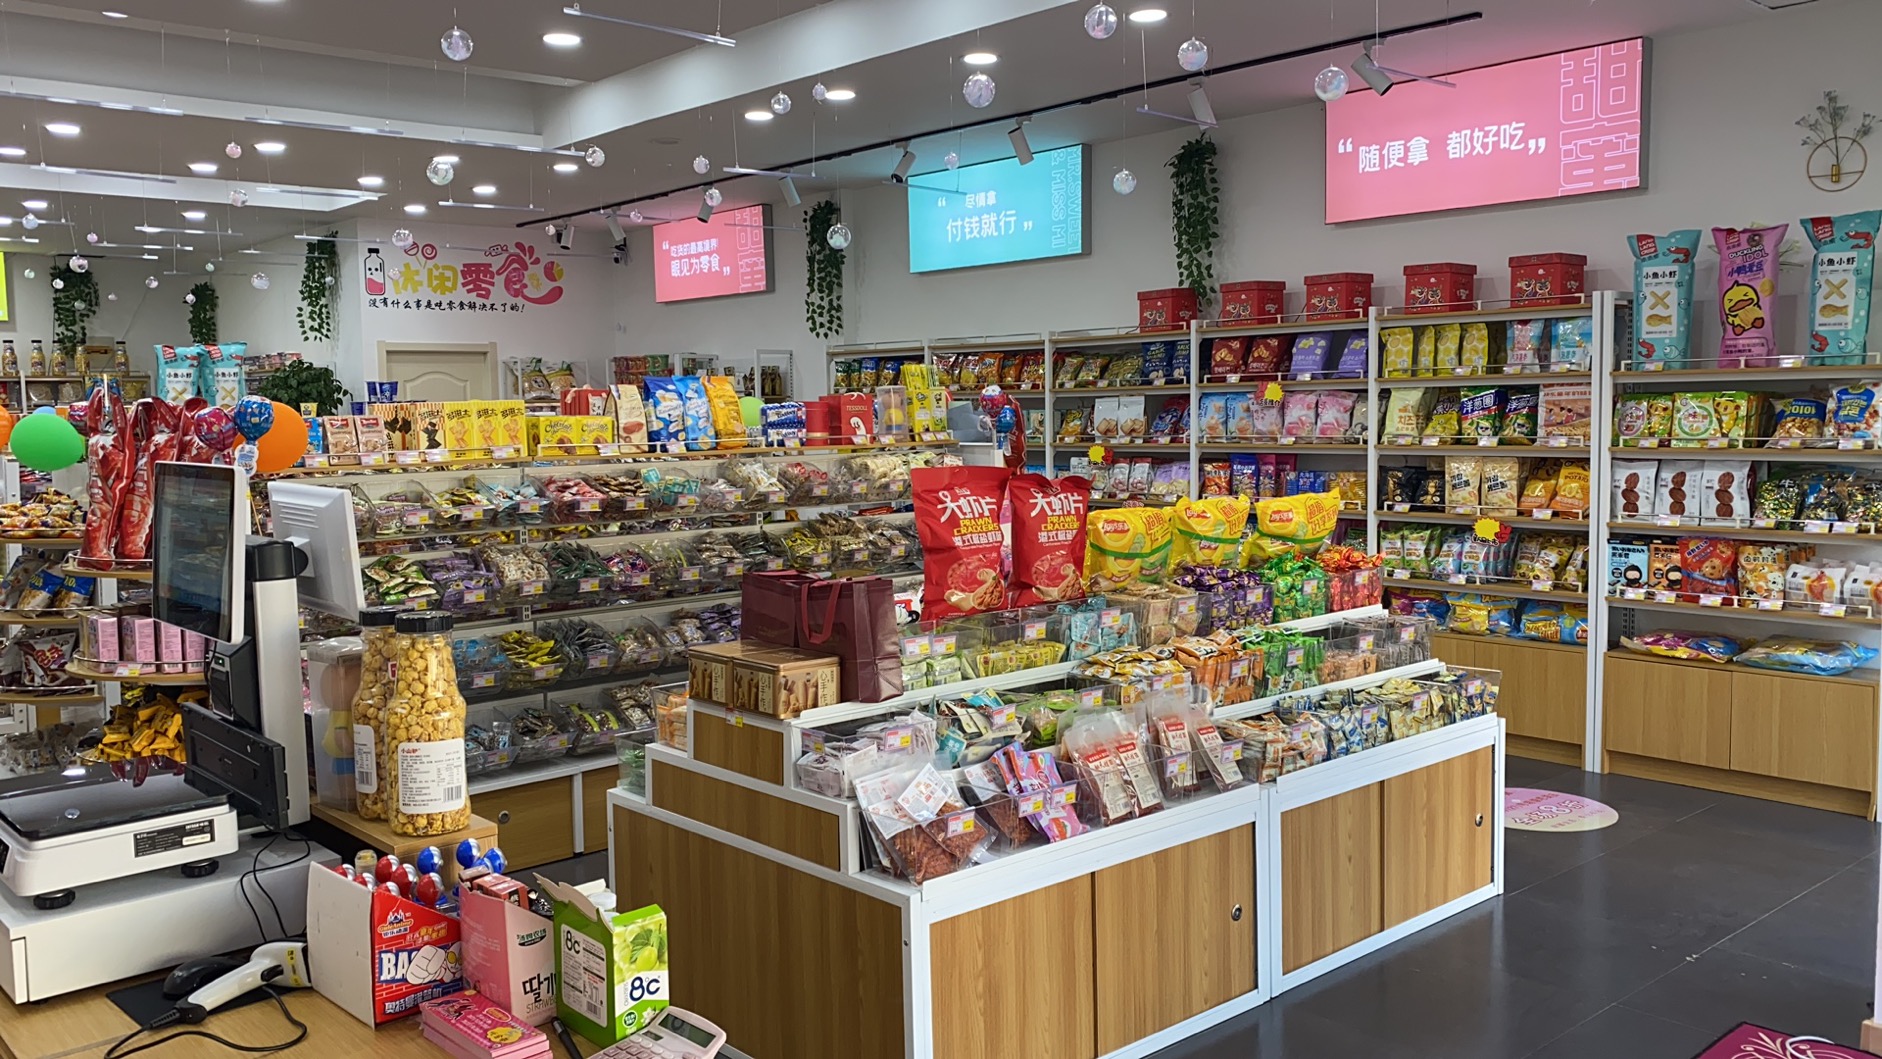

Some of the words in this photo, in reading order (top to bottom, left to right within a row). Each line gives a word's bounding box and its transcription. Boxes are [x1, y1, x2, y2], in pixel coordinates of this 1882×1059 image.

[965, 190, 997, 208] 尽情拿
[1728, 244, 1764, 259] DUCKLING
[1742, 250, 1769, 263] IDOL
[1818, 256, 1857, 267] 小鱼小虾
[1643, 270, 1678, 280] 小鱼小虾
[1463, 394, 1494, 414] 洋葱圈
[937, 489, 997, 523] 大虾片
[1029, 487, 1083, 518] 大虾片
[960, 516, 993, 527] PRAWN
[1047, 514, 1077, 524] PRAWN
[953, 523, 999, 536] CRACKERS
[380, 951, 417, 981] BA
